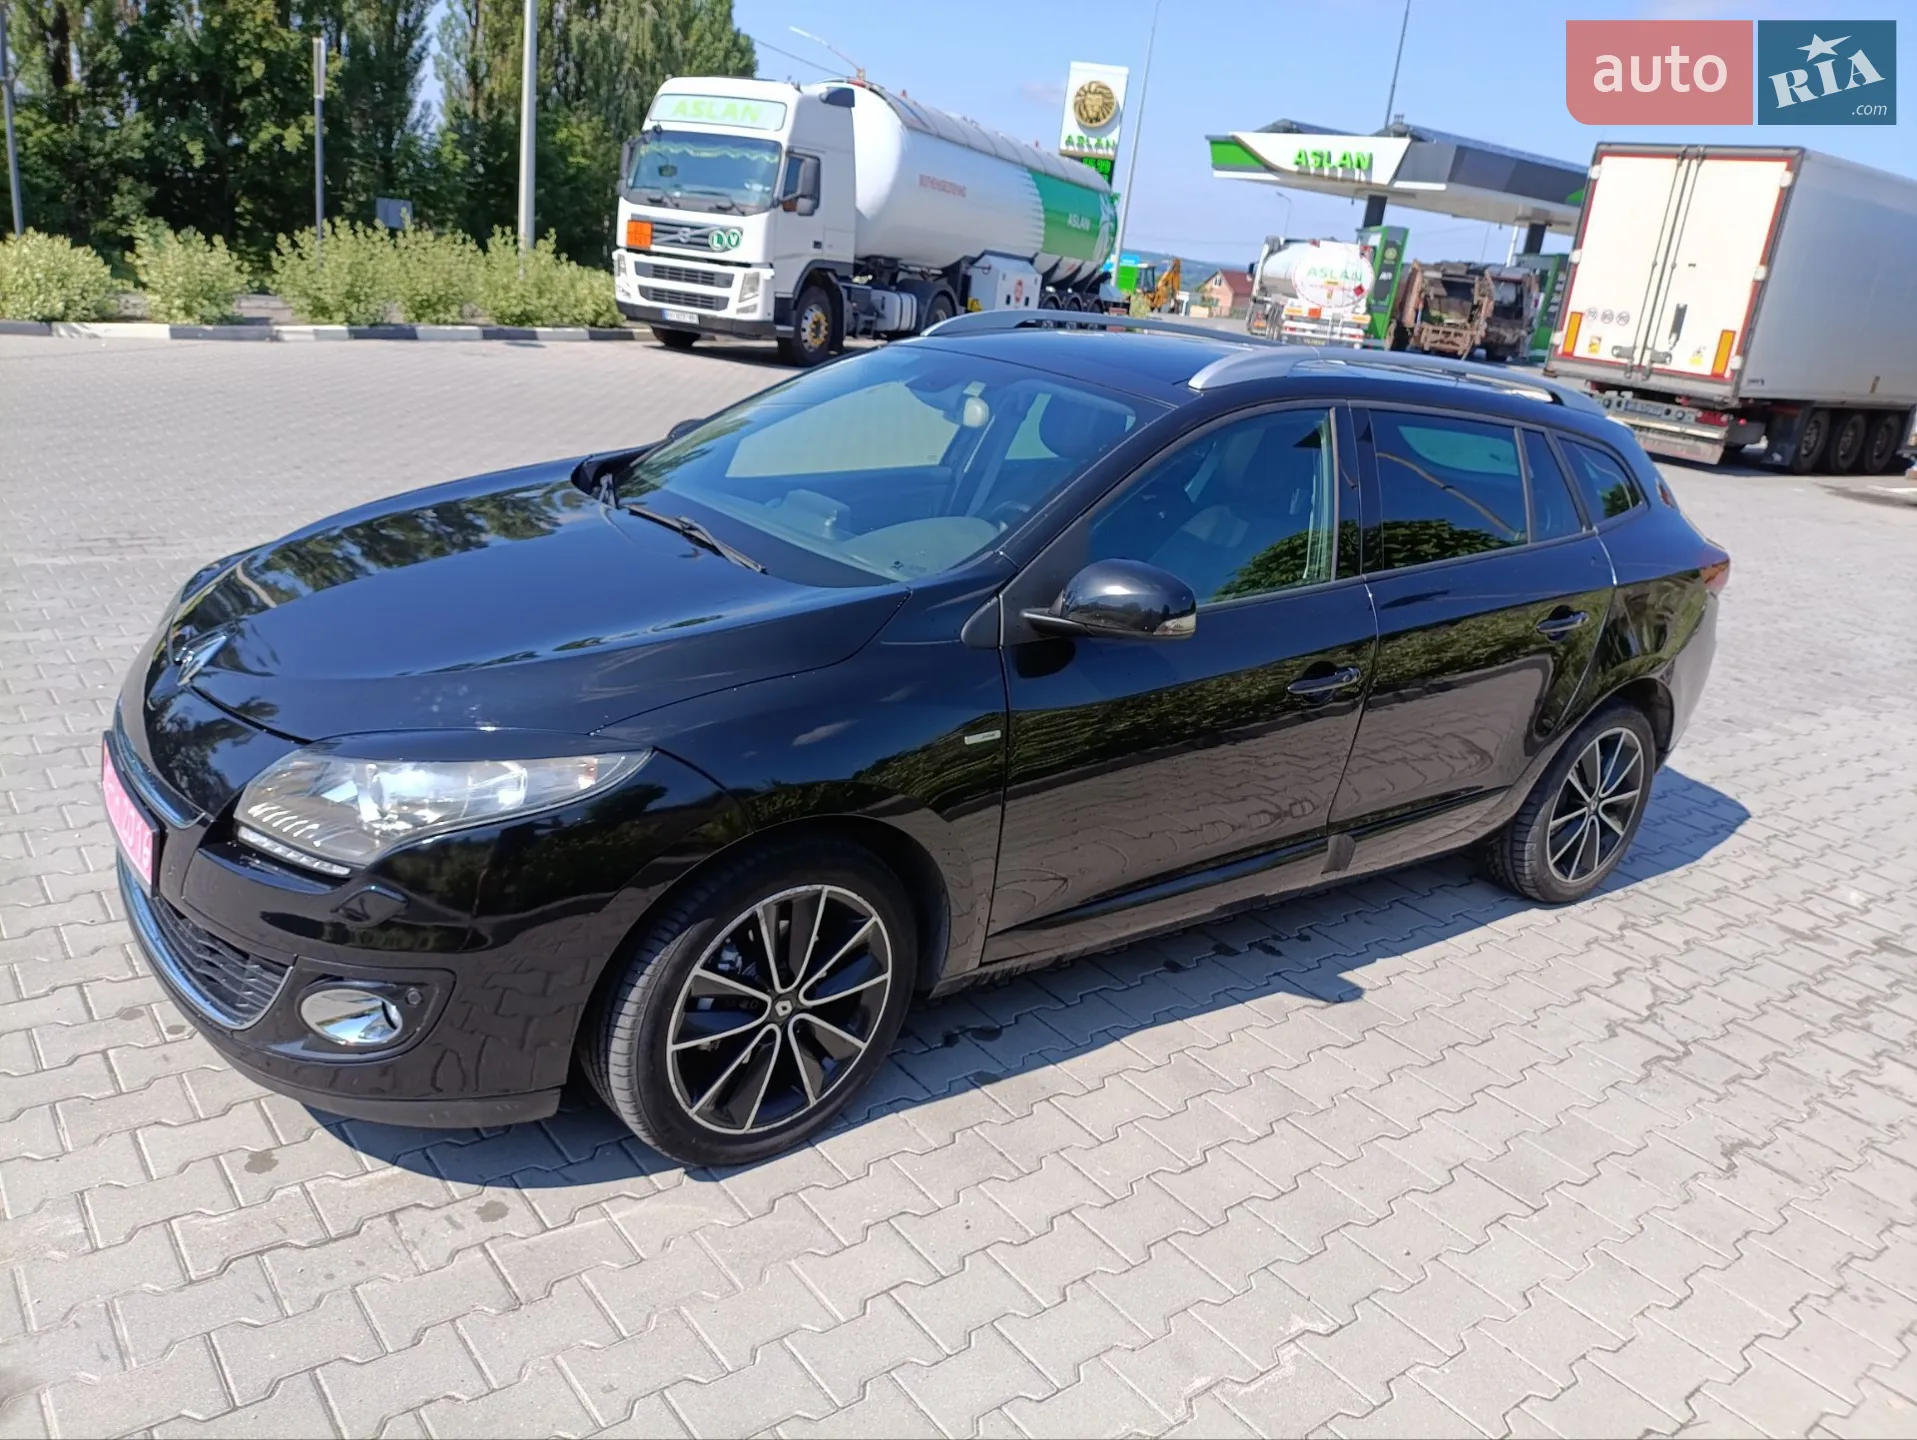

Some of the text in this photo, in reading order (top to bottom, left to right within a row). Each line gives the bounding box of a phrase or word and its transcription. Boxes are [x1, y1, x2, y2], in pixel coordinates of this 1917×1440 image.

[670, 98, 763, 122] ASLAN
[1064, 134, 1115, 151] ASLAN
[1293, 148, 1373, 170] ASLAN
[1066, 212, 1092, 232] ASLAN
[1307, 266, 1364, 283] ASLAN
